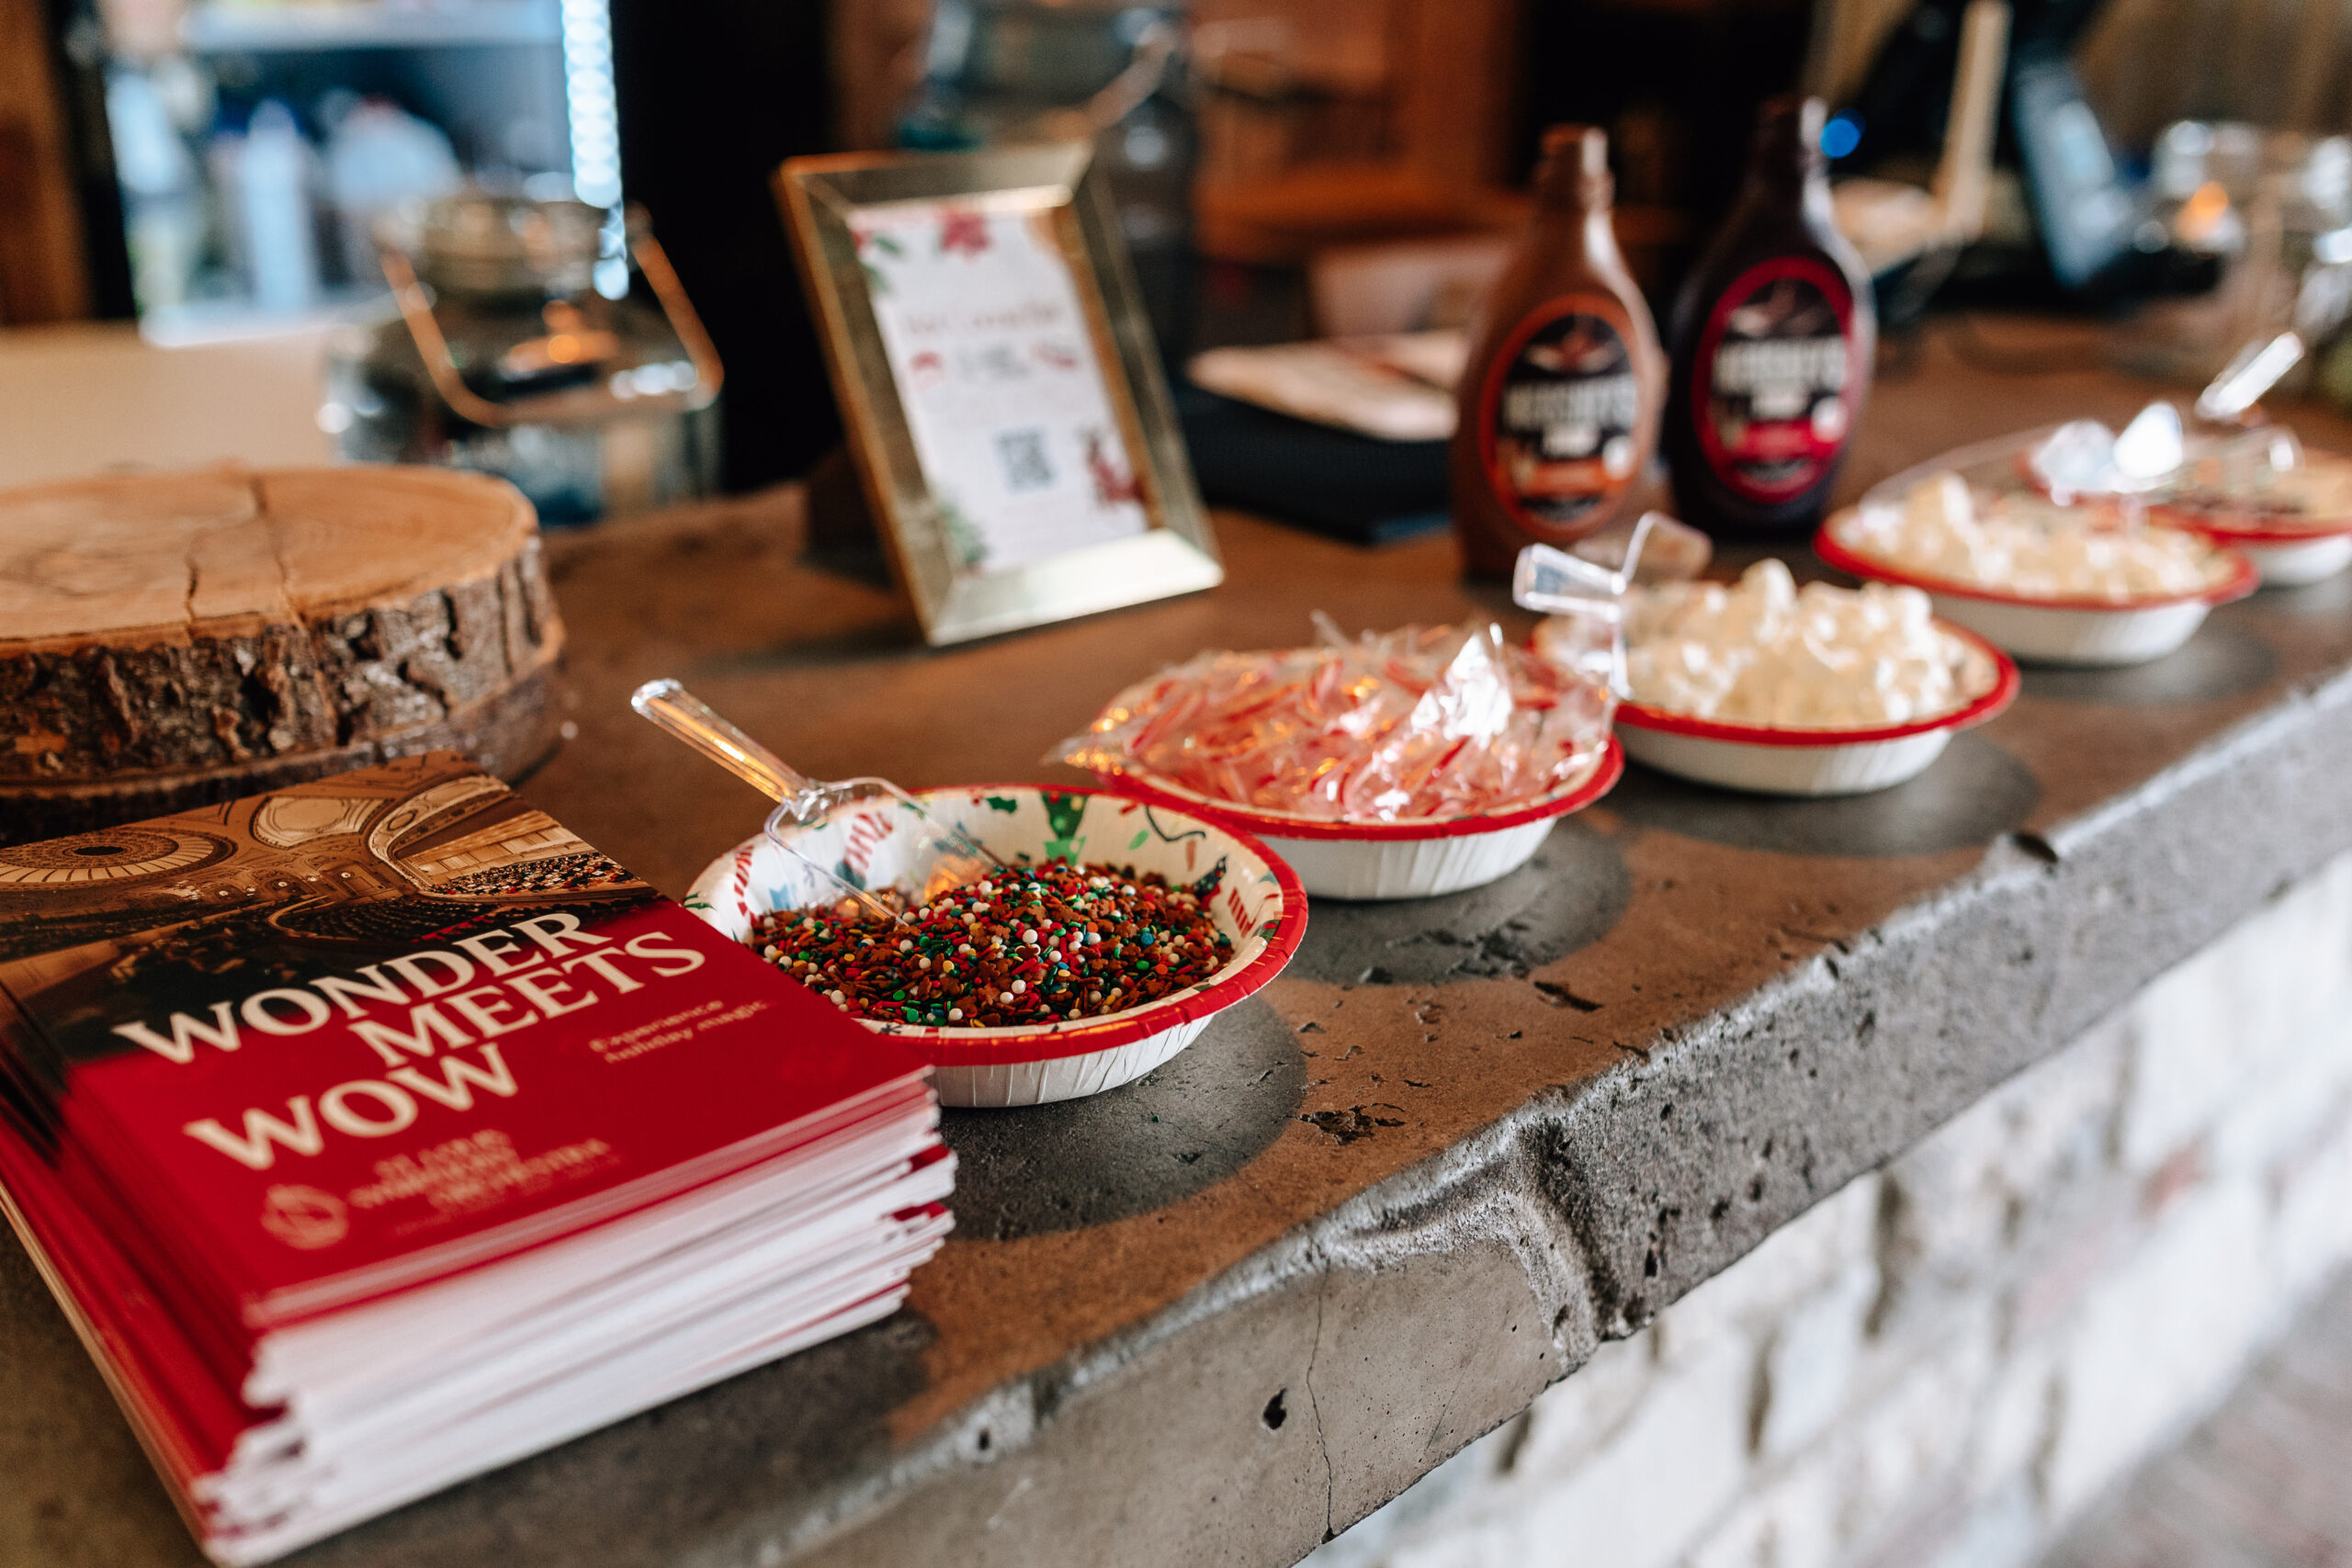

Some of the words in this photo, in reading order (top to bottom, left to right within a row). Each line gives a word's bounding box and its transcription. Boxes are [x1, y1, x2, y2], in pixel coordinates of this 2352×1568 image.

[110, 913, 613, 1064] WONDER
[347, 931, 706, 1068] MEETS
[183, 1042, 518, 1171] WOW
